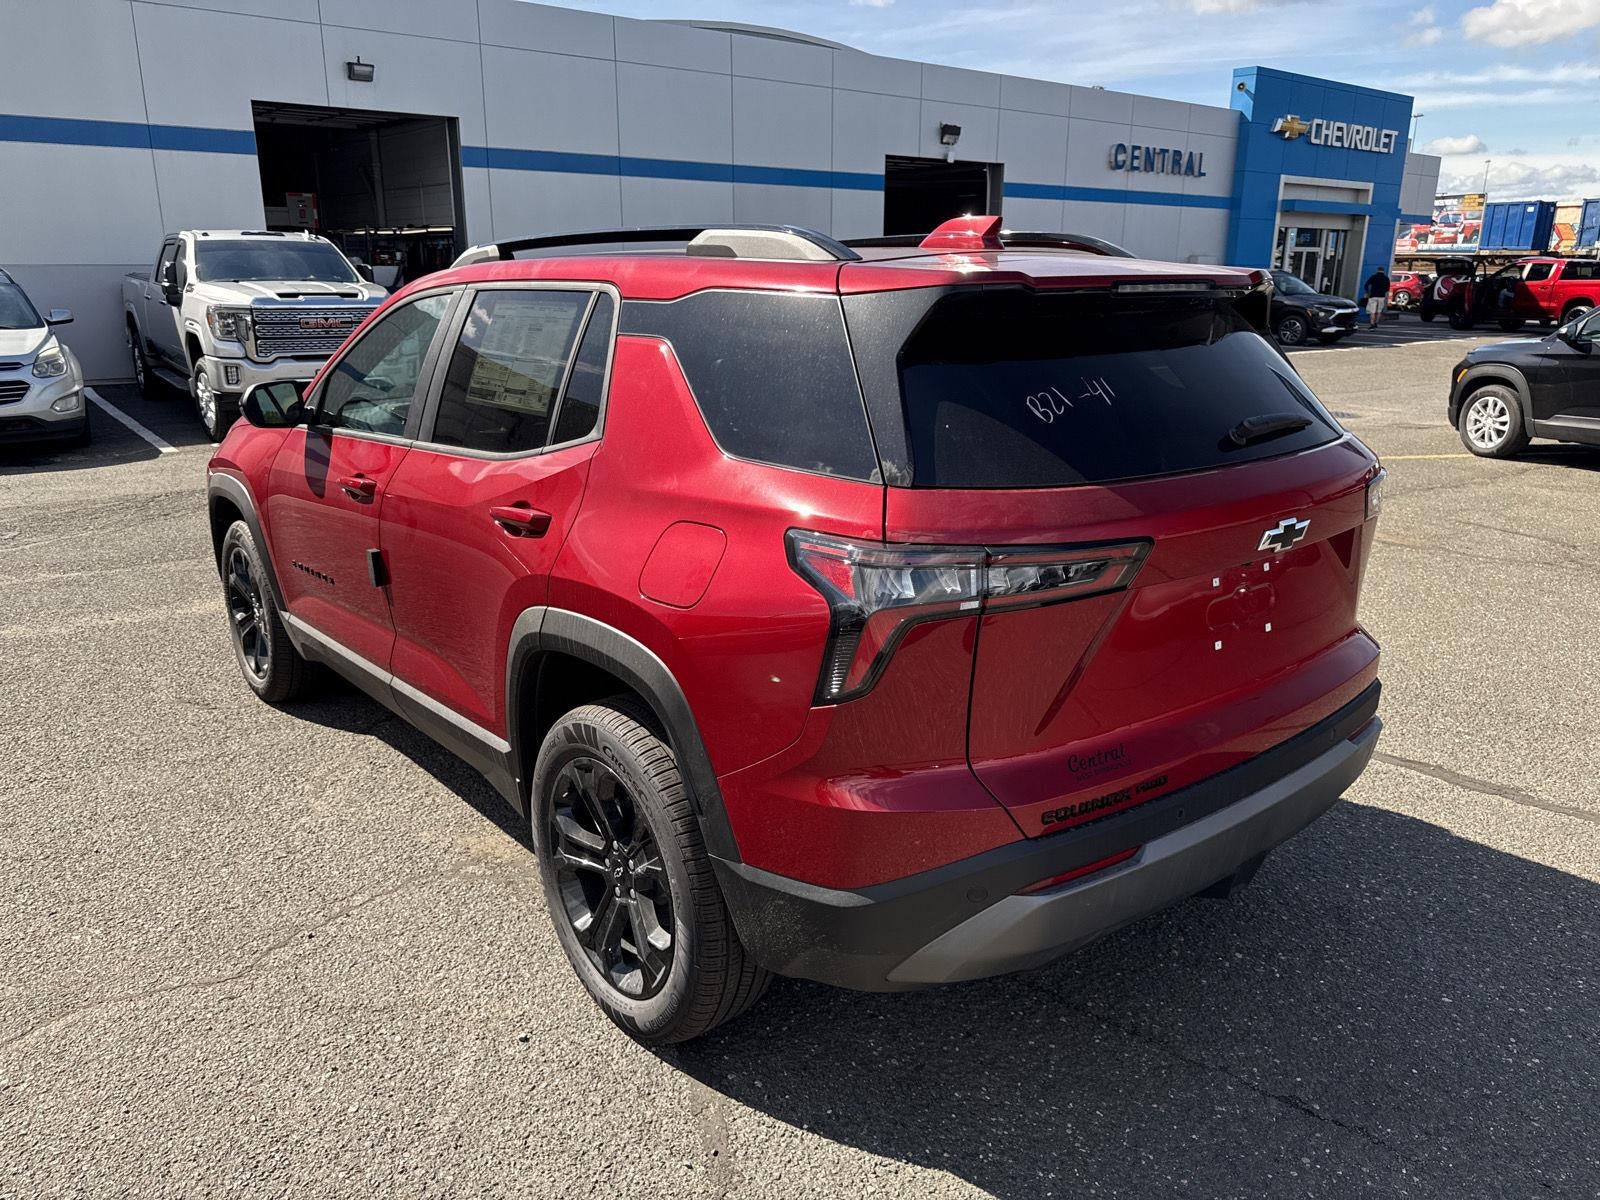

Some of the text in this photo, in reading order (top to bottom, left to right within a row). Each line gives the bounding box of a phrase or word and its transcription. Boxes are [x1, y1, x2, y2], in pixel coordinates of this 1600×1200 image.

[1310, 118, 1399, 154] CHEVROLET
[1110, 143, 1207, 177] CENTRAL
[299, 317, 352, 329] GMC
[1068, 743, 1126, 773] Central
